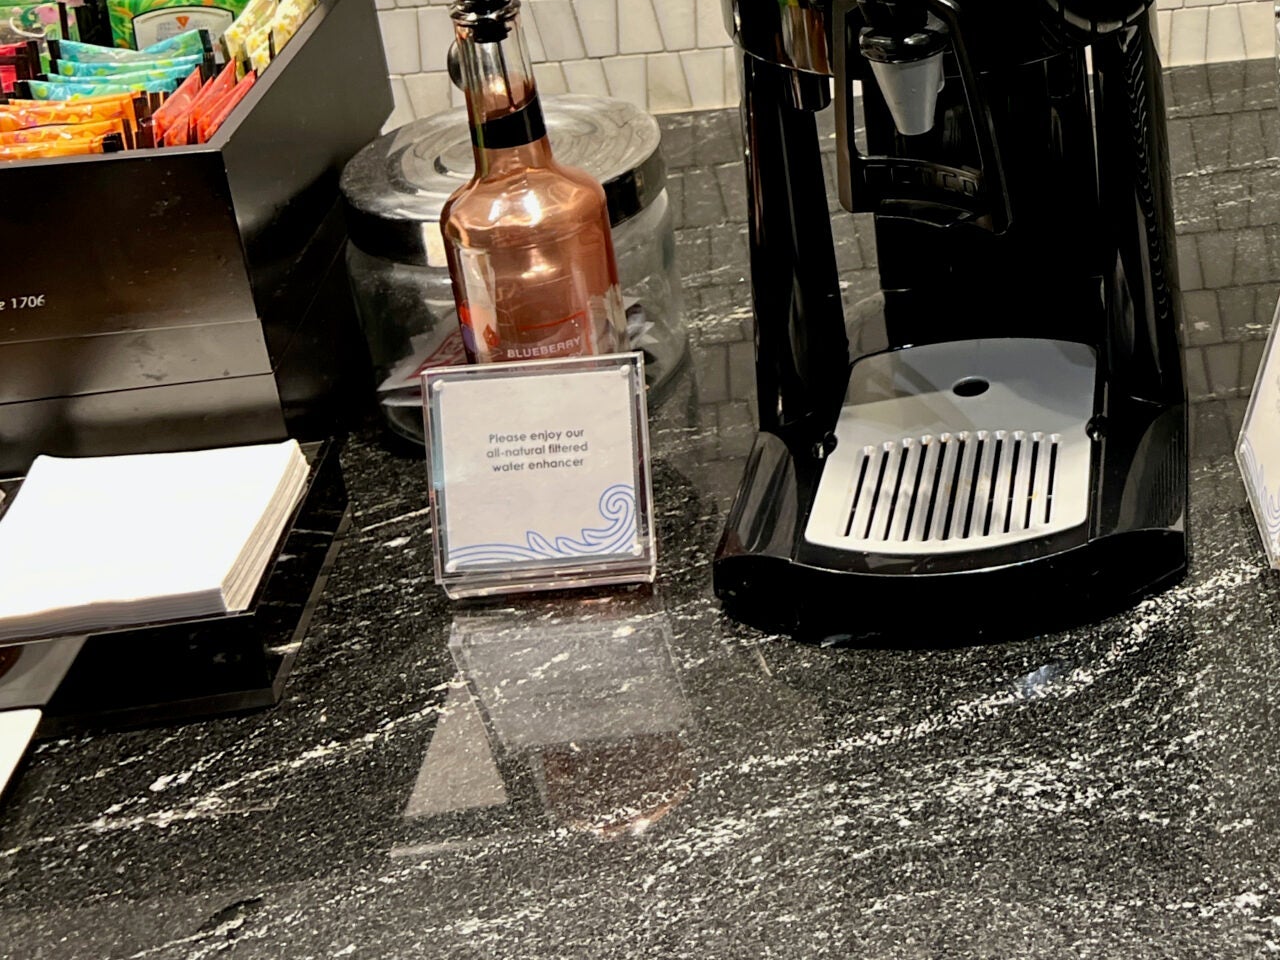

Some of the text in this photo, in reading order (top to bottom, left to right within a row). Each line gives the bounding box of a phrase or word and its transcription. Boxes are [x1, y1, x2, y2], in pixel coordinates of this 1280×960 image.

[11, 294, 46, 309] 1706
[507, 336, 581, 358] BLUEBERRY
[489, 429, 584, 444] Please enjoy our
[486, 442, 588, 458] all-natural filtered
[493, 458, 584, 472] water enhancer
